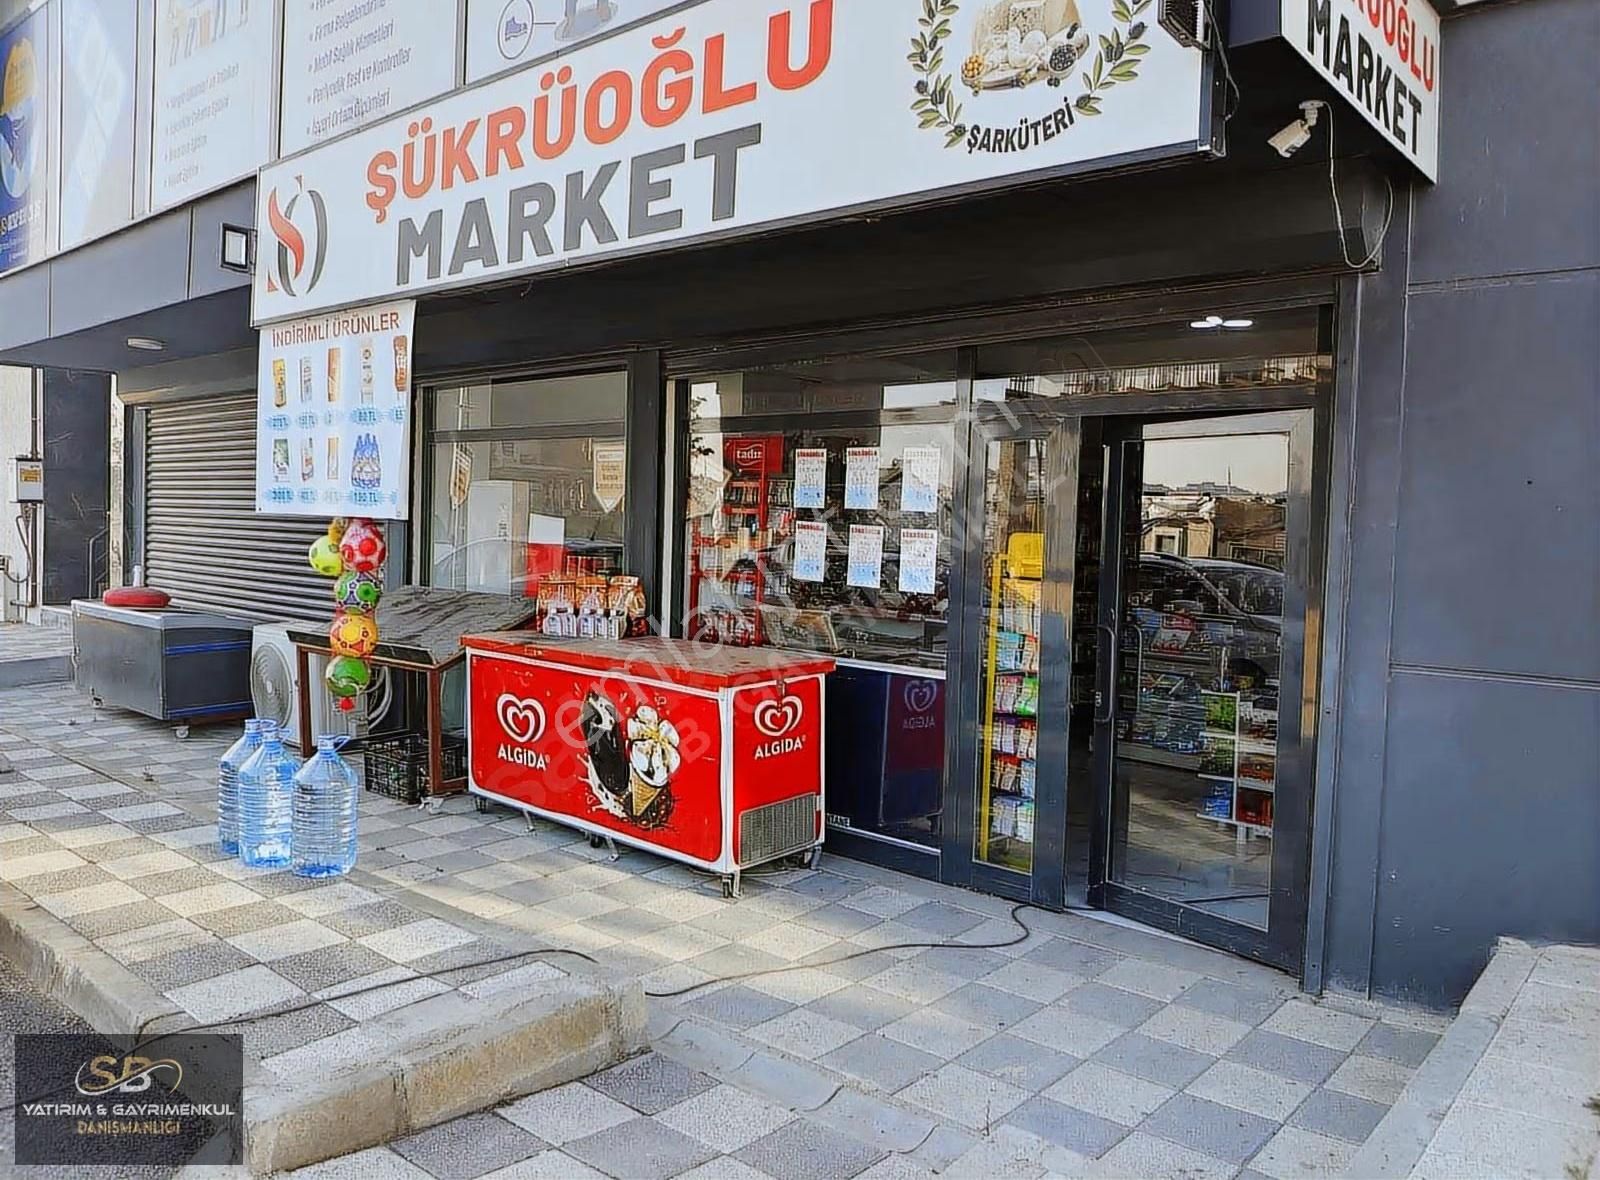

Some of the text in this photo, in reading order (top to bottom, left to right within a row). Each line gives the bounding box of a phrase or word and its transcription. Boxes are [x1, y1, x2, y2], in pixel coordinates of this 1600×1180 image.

[366, 0, 832, 223] ŞÜKRÜOĞLU
[967, 96, 1075, 154] ŞARKÜTERİ
[1308, 0, 1422, 156] MARKET
[396, 122, 762, 286] MARKET
[272, 311, 400, 348] İNDİRİMLİ ÜRÜNLER
